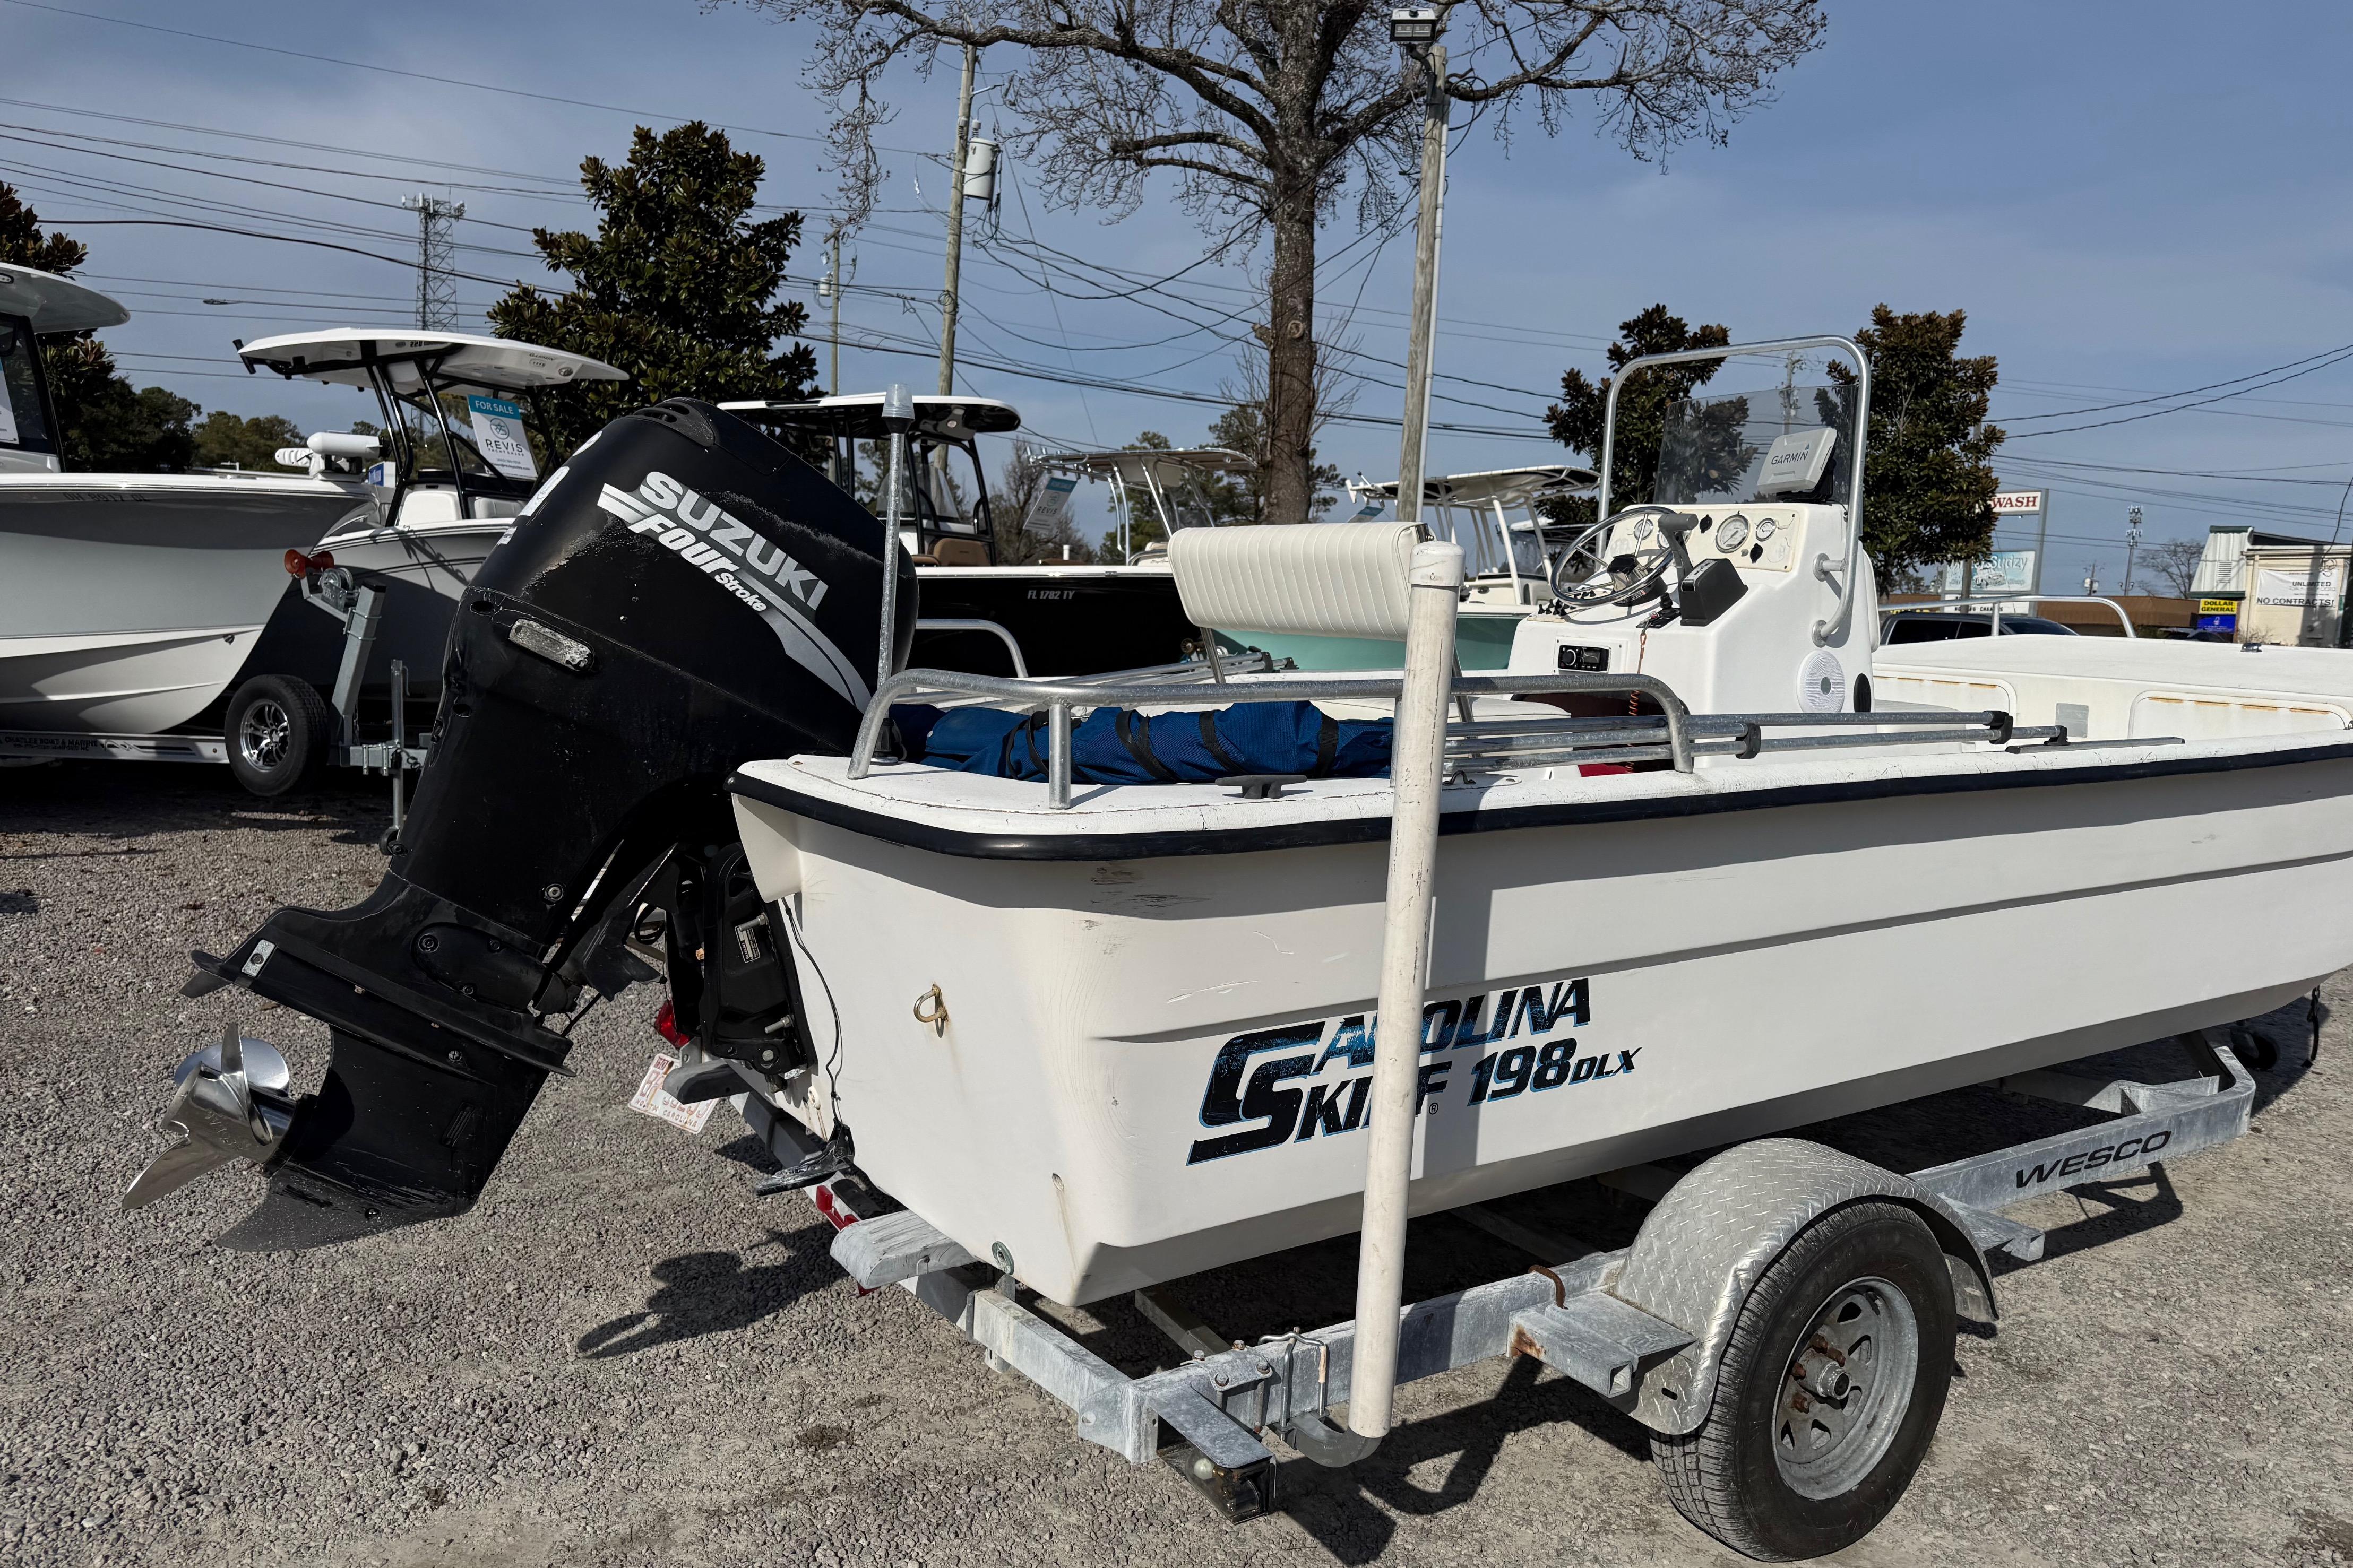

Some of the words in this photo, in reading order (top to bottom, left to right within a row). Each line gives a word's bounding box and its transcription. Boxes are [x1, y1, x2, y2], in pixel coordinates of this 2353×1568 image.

[475, 401, 492, 410] FOR
[493, 404, 514, 414] SALE
[485, 439, 523, 452] REVIS
[1771, 451, 1808, 465] GARMIN
[1037, 506, 1058, 515] REVIS
[640, 471, 829, 611] SUZUKI
[1027, 590, 1037, 599] FL
[1040, 590, 1061, 599] 1782
[1063, 590, 1075, 599] TY
[1199, 978, 1590, 1128] CAOLINA
[1186, 1053, 1452, 1166] SKIF
[2016, 1130, 2171, 1189] WESCO
